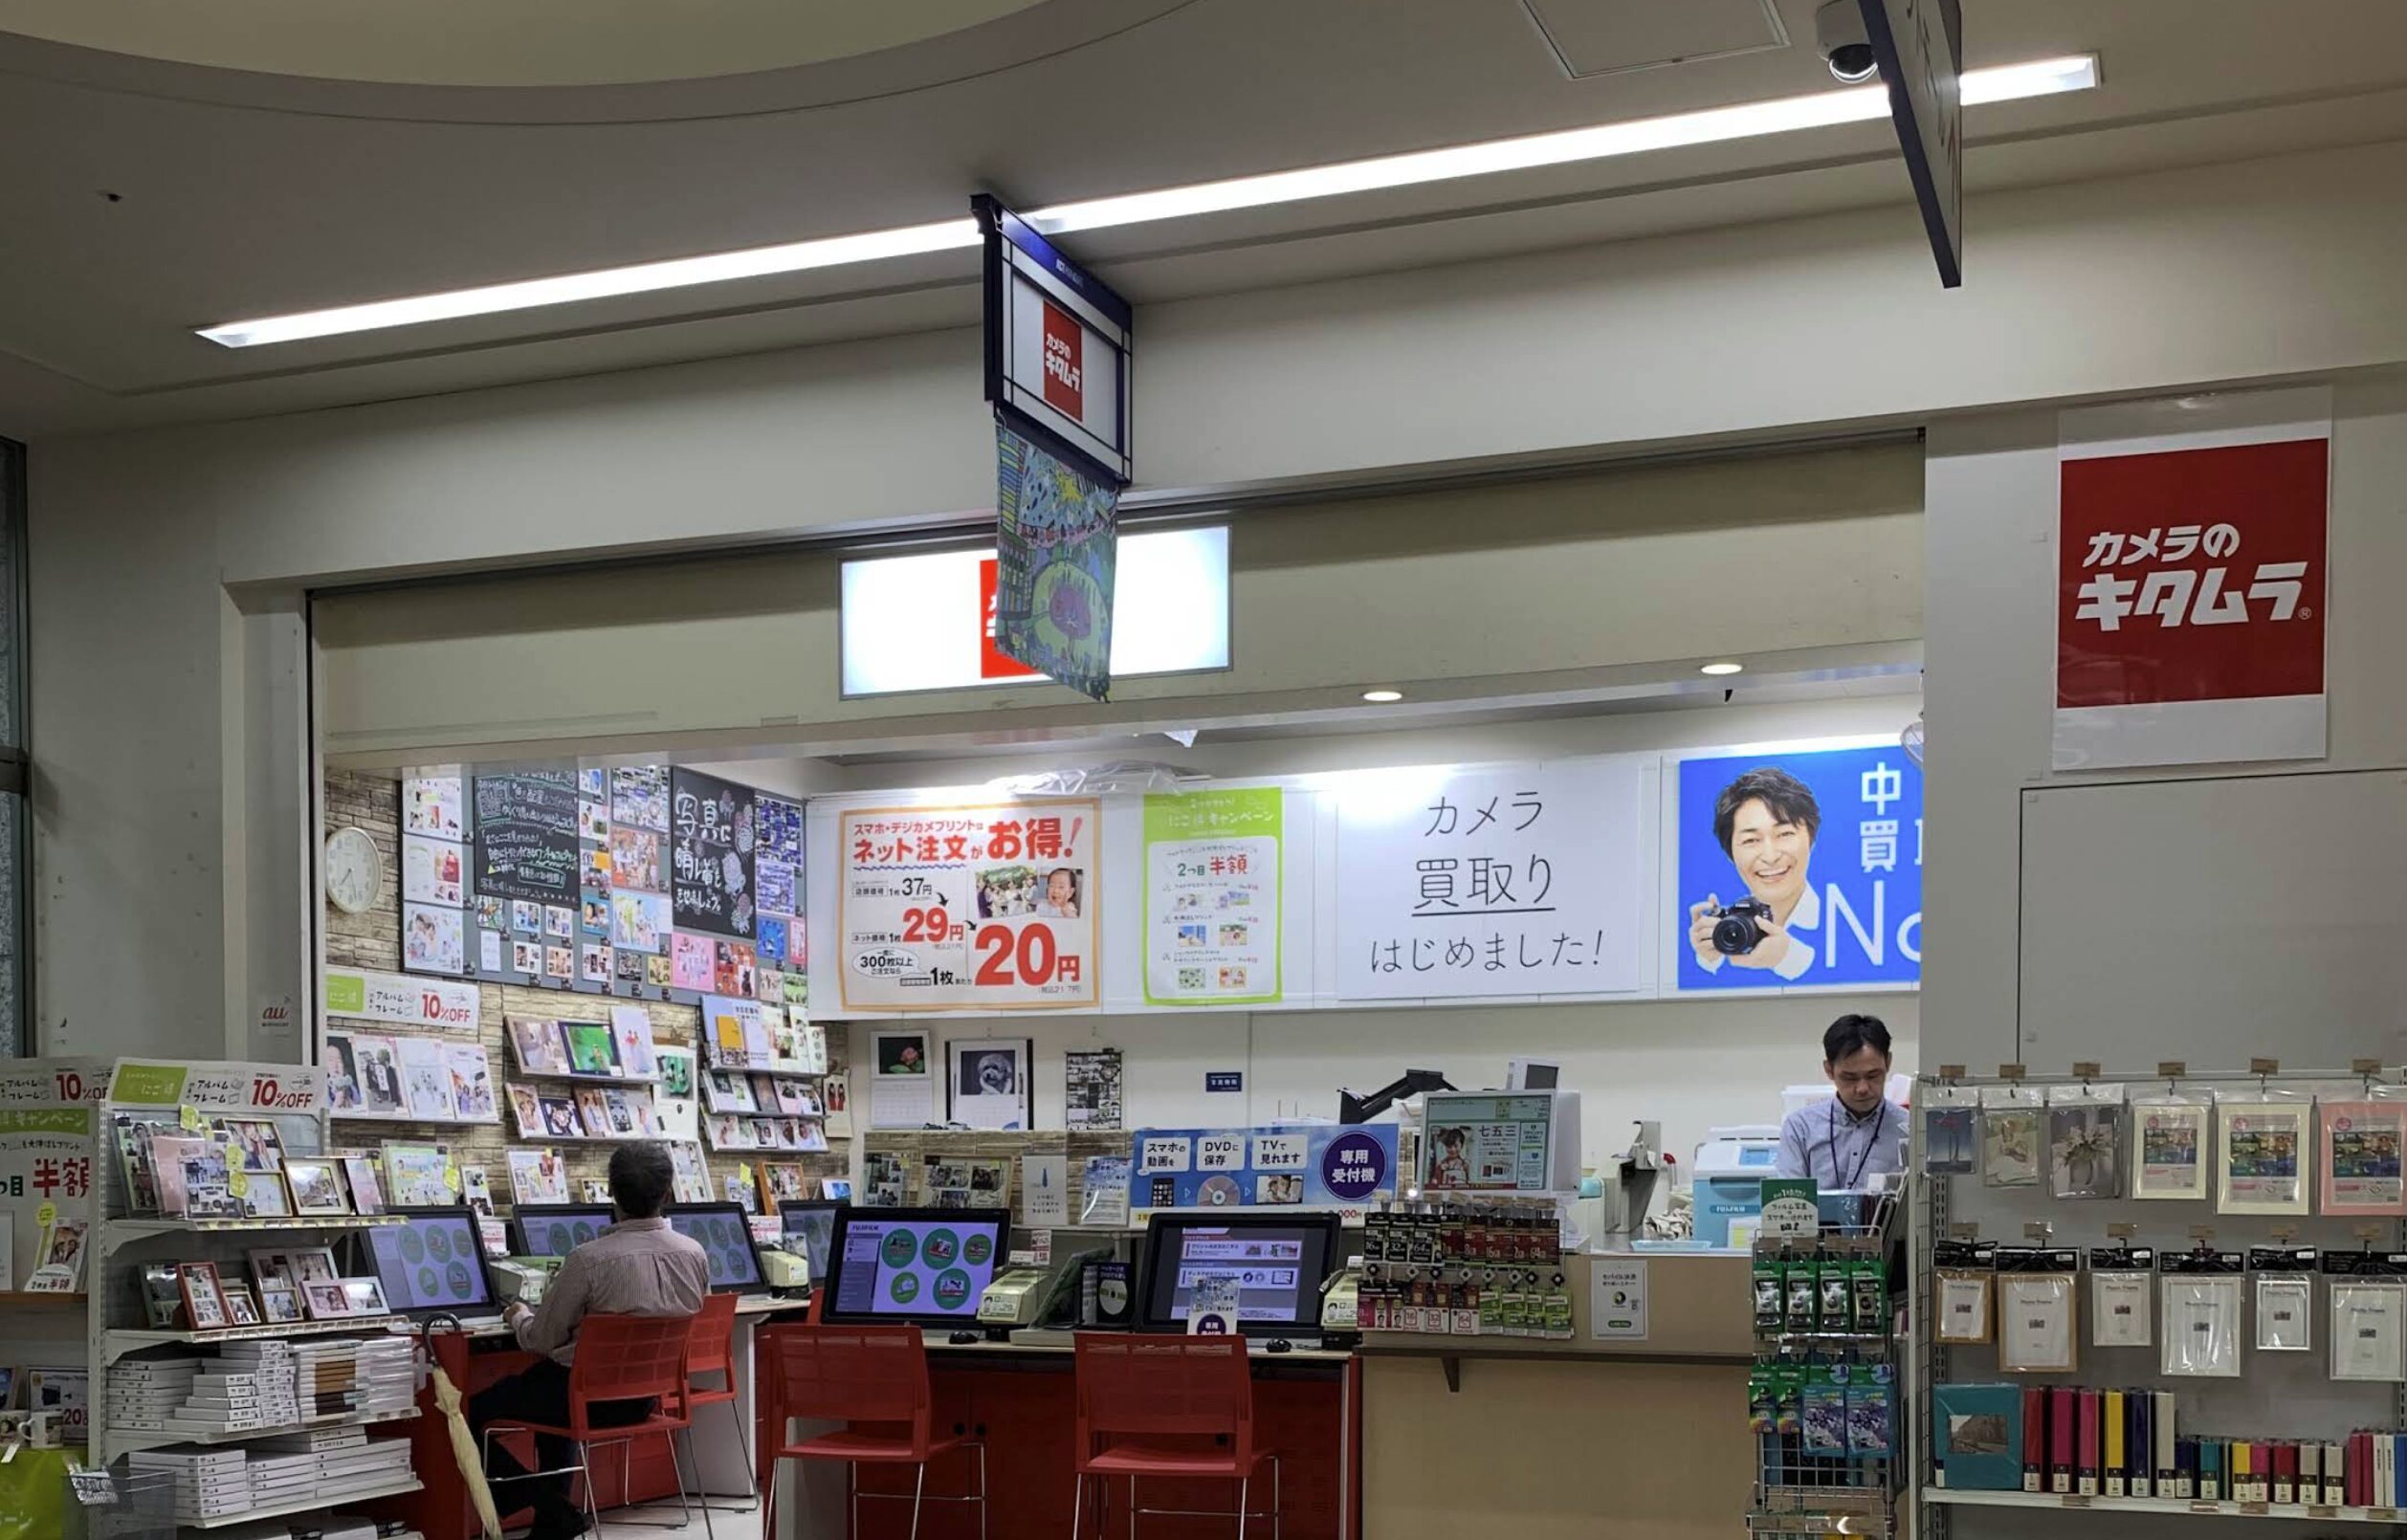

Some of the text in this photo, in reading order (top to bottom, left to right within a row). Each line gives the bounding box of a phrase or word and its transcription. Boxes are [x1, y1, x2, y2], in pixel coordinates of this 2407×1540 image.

[1046, 333, 1071, 360] カメラの
[1046, 348, 1081, 392] キタムラ
[2083, 523, 2241, 567] カメラの
[2075, 561, 2308, 631] キタムラ
[1424, 790, 1543, 838] カメラ
[853, 816, 1083, 863] ネット注文が お得!
[1860, 819, 1923, 873] 買
[1209, 854, 1248, 876] 半額
[901, 877, 932, 897] 37円
[1413, 853, 1553, 911] 買取り
[902, 907, 964, 943] 29円
[860, 956, 914, 968] 300枚以上
[974, 922, 1081, 987] 20円
[1370, 930, 1604, 974] はじめました!
[262, 1006, 288, 1020] au
[252, 1079, 314, 1108] 10%OFF
[1479, 1125, 1516, 1137] 七五三
[1147, 1141, 1186, 1153] スマホの
[1204, 1141, 1240, 1153] DVDに
[1261, 1139, 1288, 1151] TVで
[1147, 1155, 1176, 1167] 動画を
[1204, 1155, 1226, 1166] 保存
[1260, 1153, 1301, 1165] 見れます
[1339, 1149, 1369, 1165] 専用
[1331, 1168, 1377, 1184] 受付機
